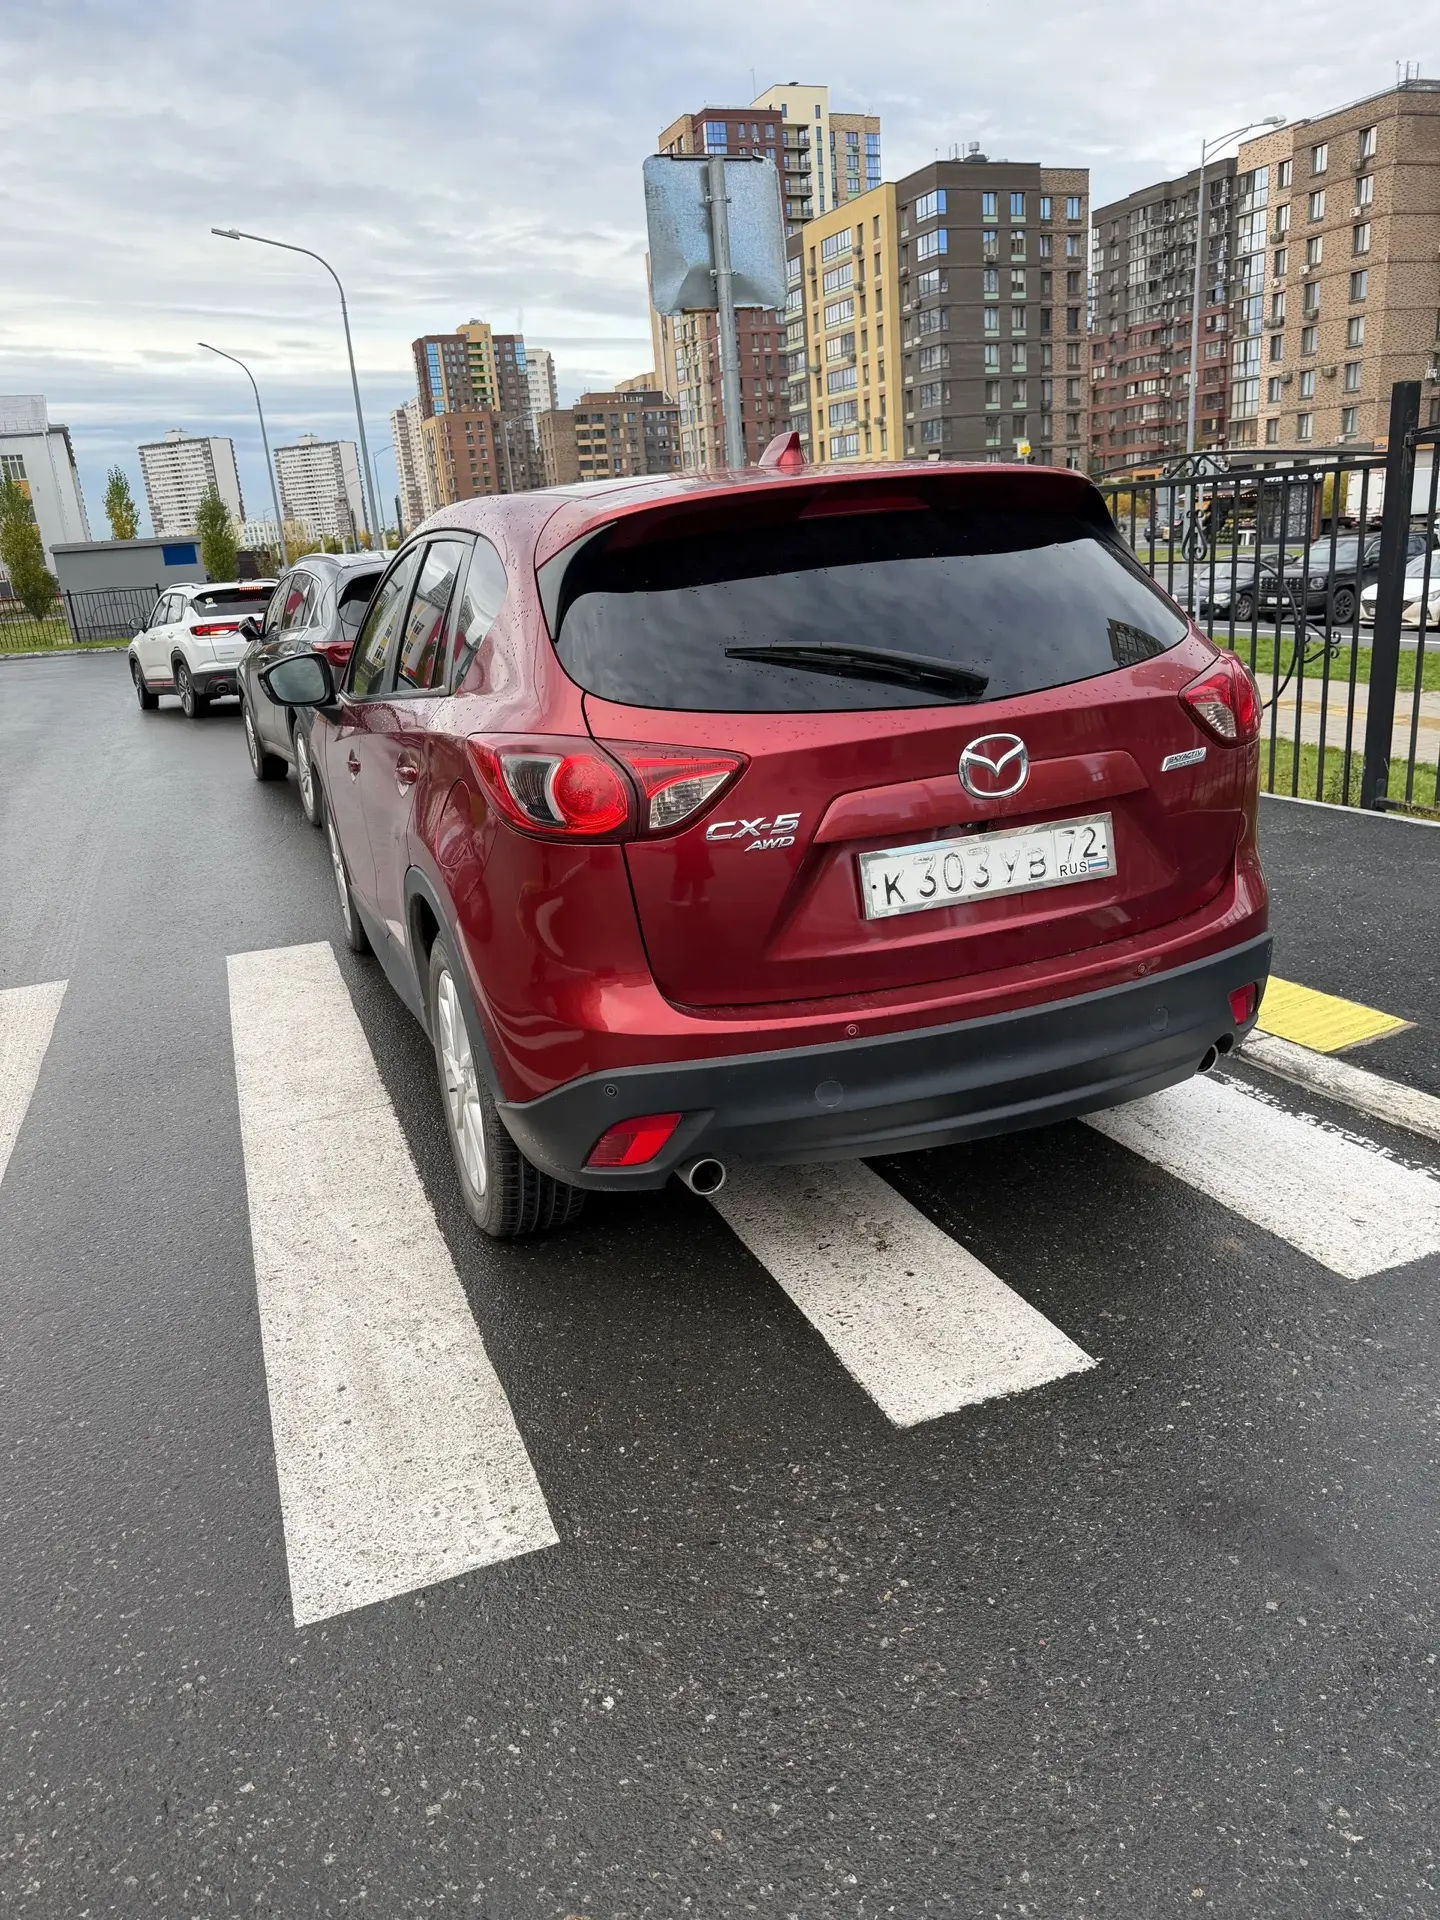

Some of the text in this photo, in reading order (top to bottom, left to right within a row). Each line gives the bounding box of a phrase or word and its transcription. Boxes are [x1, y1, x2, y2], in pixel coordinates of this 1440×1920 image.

[706, 812, 802, 841] CX-5
[744, 836, 795, 852] AWD
[1058, 826, 1098, 863] 72
[1059, 860, 1088, 877] RUS
